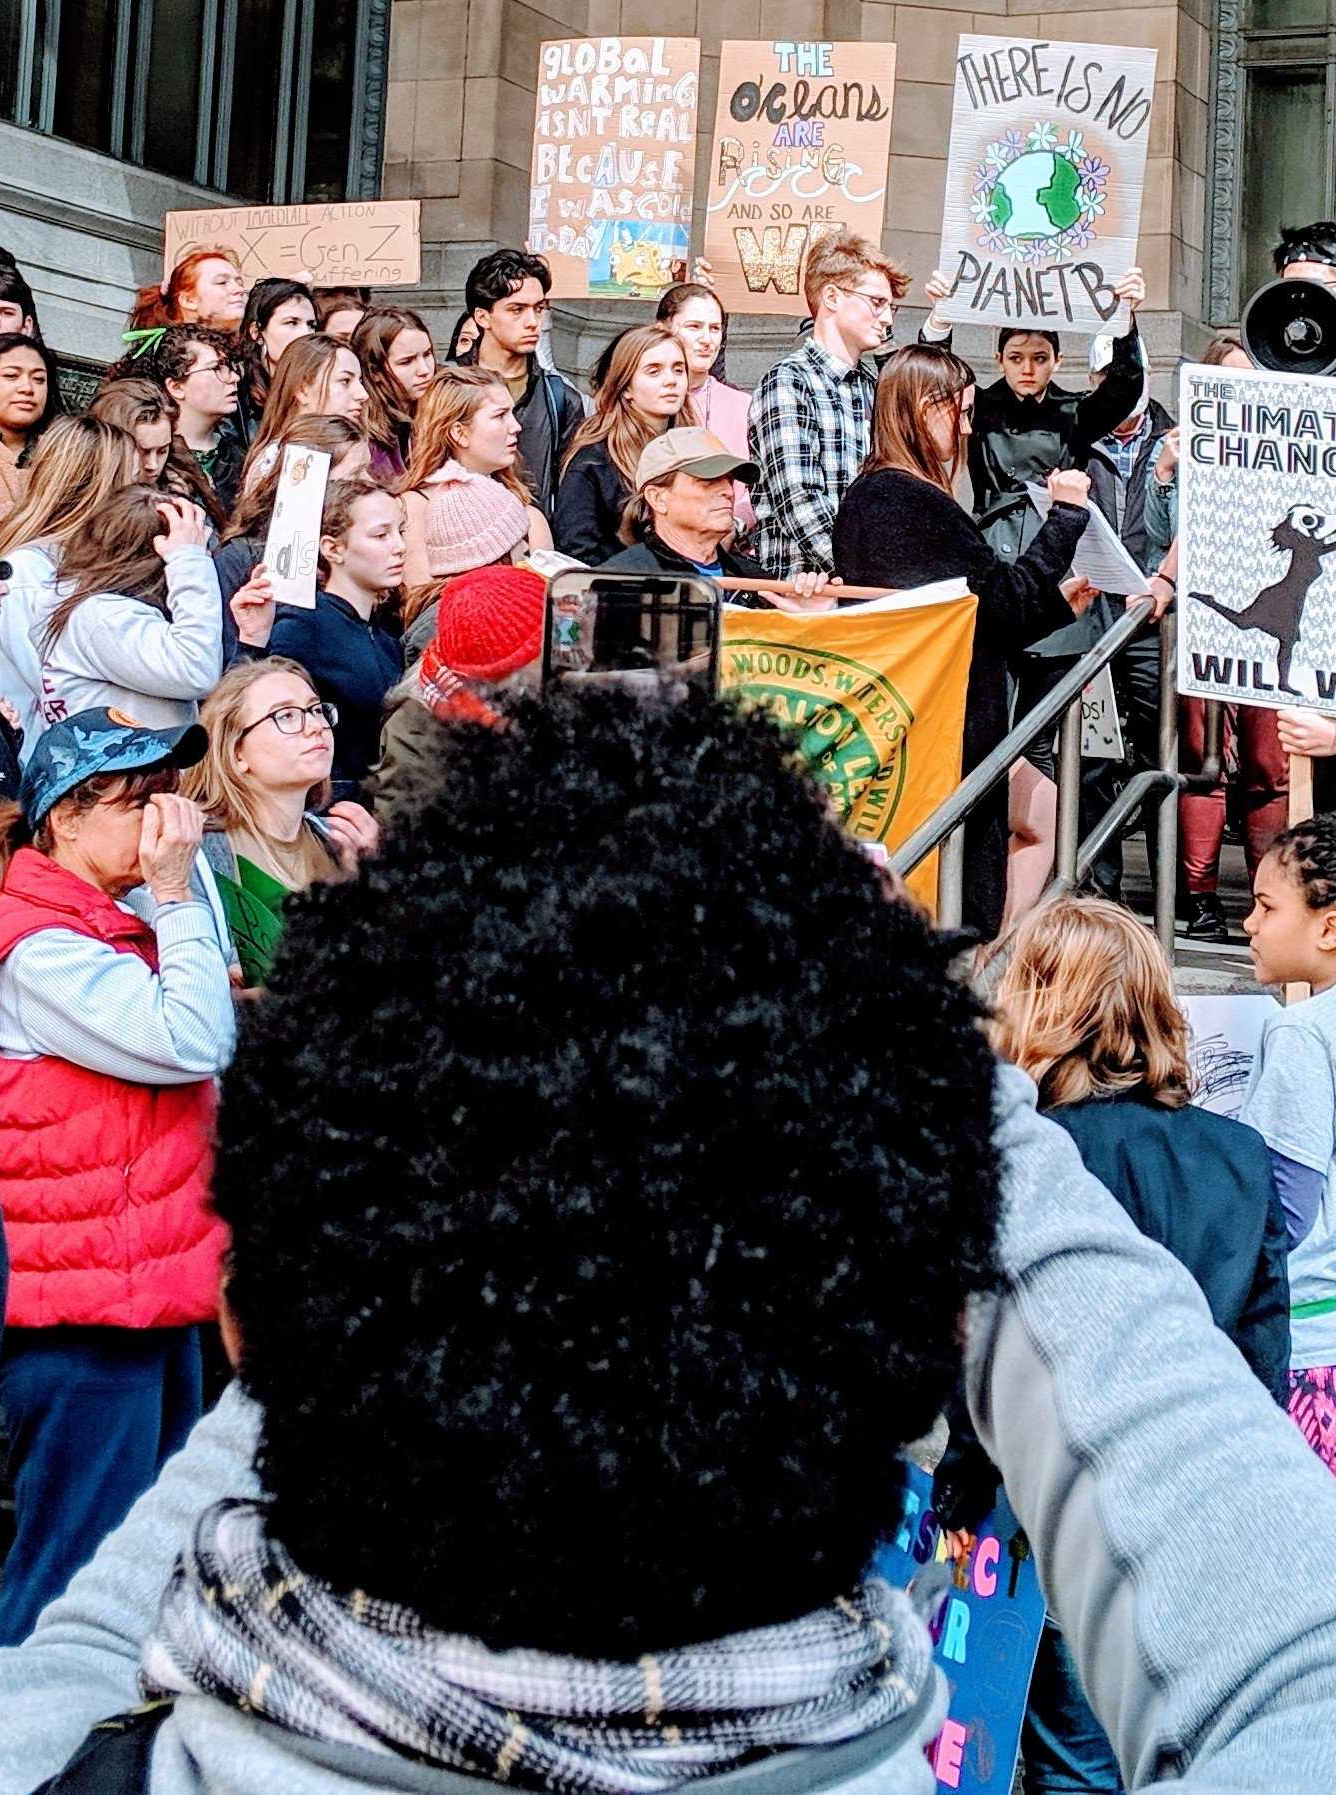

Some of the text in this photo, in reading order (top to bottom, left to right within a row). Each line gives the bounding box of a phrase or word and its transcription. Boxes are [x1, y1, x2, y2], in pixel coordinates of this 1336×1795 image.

[772, 41, 834, 77] THE
[957, 43, 1152, 141] THERE IS NO
[773, 120, 826, 148] ARE
[530, 184, 552, 222] I
[727, 202, 834, 221] AND SO ARE
[174, 209, 241, 241] WITHOUT
[321, 204, 377, 223] ACTION
[239, 231, 269, 270] X
[299, 225, 359, 269] Gen
[364, 224, 404, 262] Z
[1069, 261, 1122, 322] B
[1190, 380, 1235, 400] THE
[1081, 699, 1106, 721] DS!
[854, 788, 891, 834] WIL
